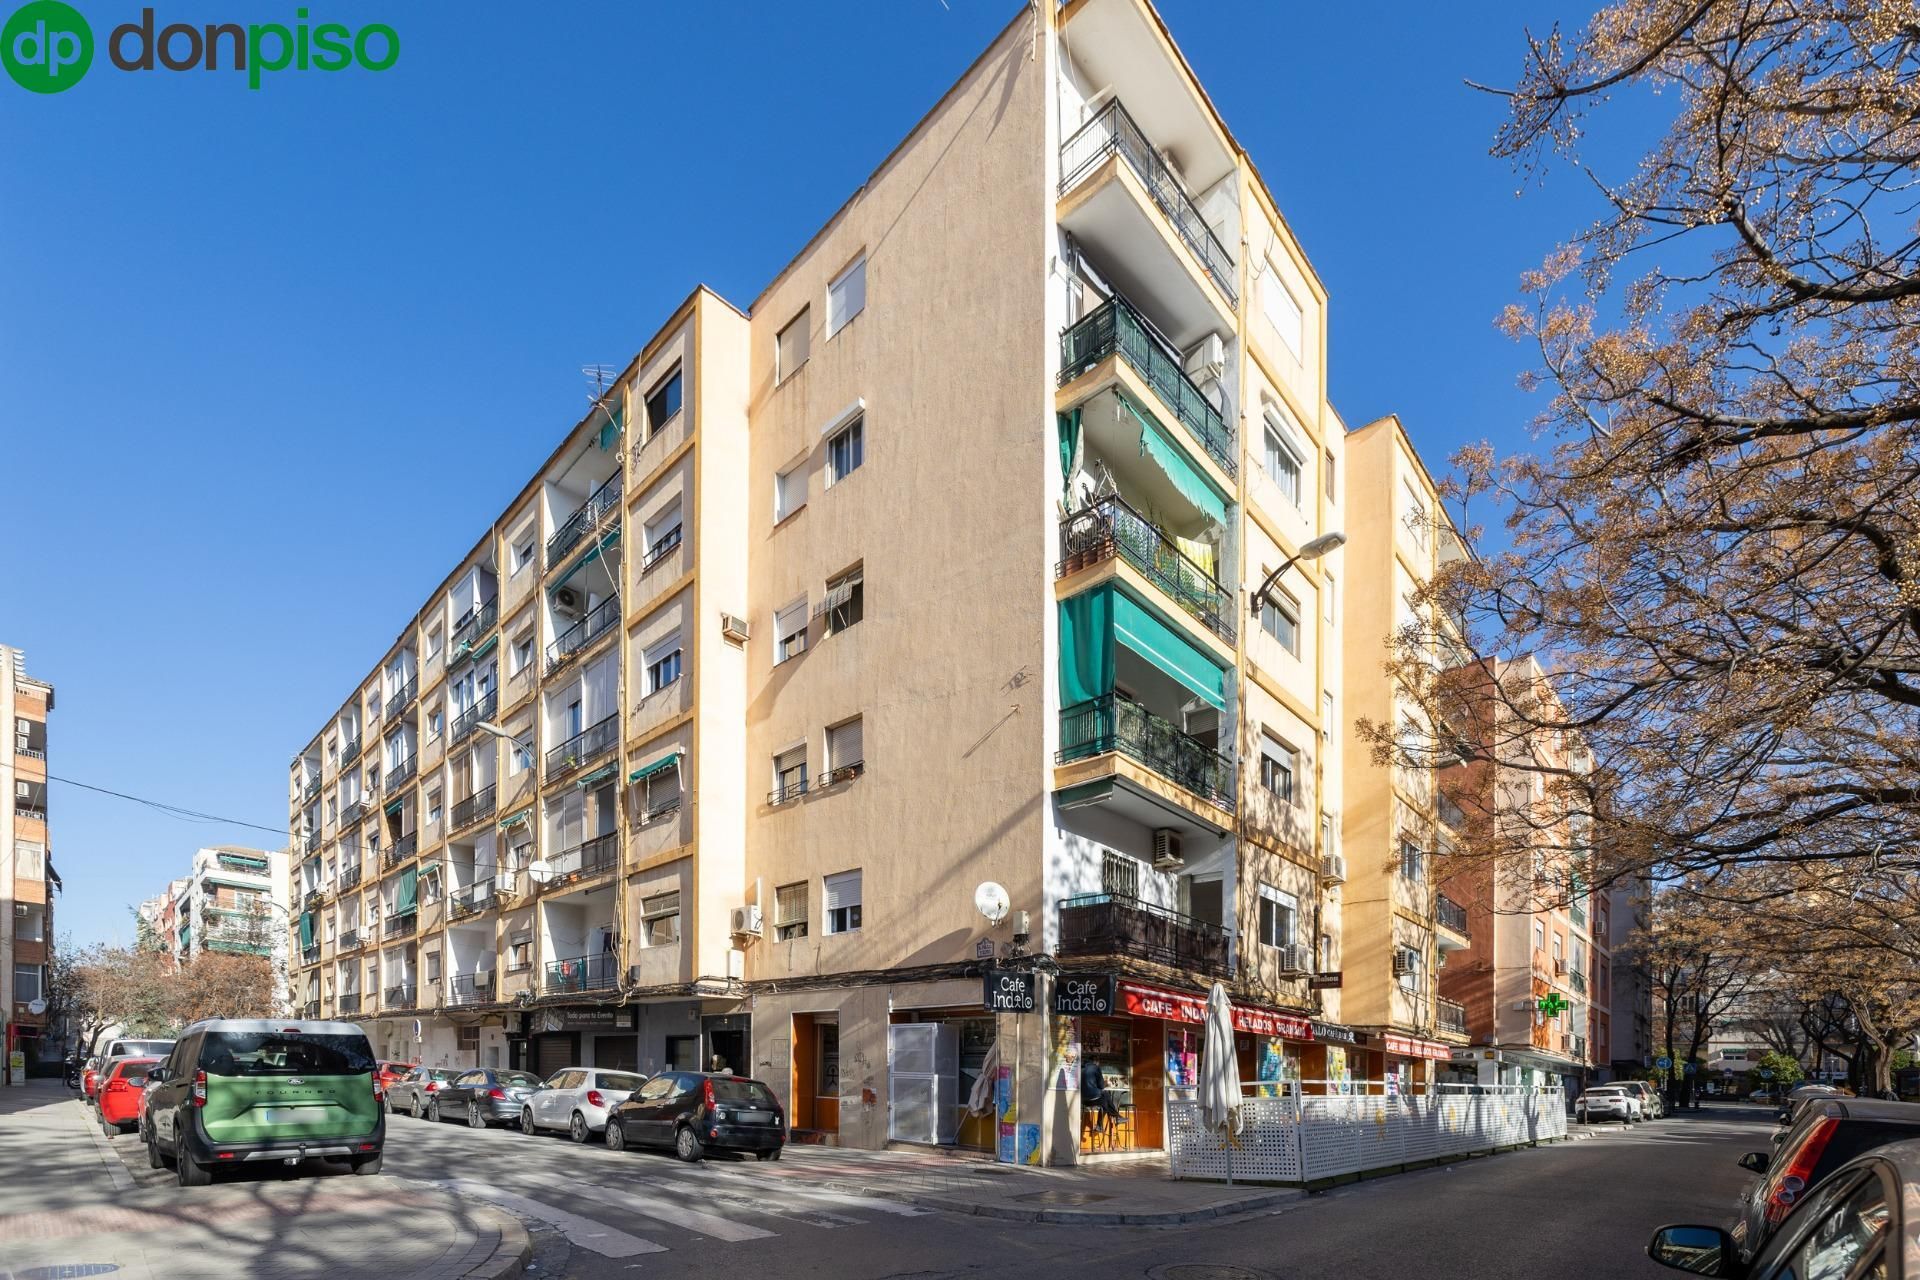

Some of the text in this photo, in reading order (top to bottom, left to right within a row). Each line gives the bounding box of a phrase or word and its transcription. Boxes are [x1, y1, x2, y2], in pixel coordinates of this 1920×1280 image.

[1000, 976, 1026, 992] Cafe
[1067, 980, 1098, 995] Cafe
[1141, 998, 1173, 1016] CAFE
